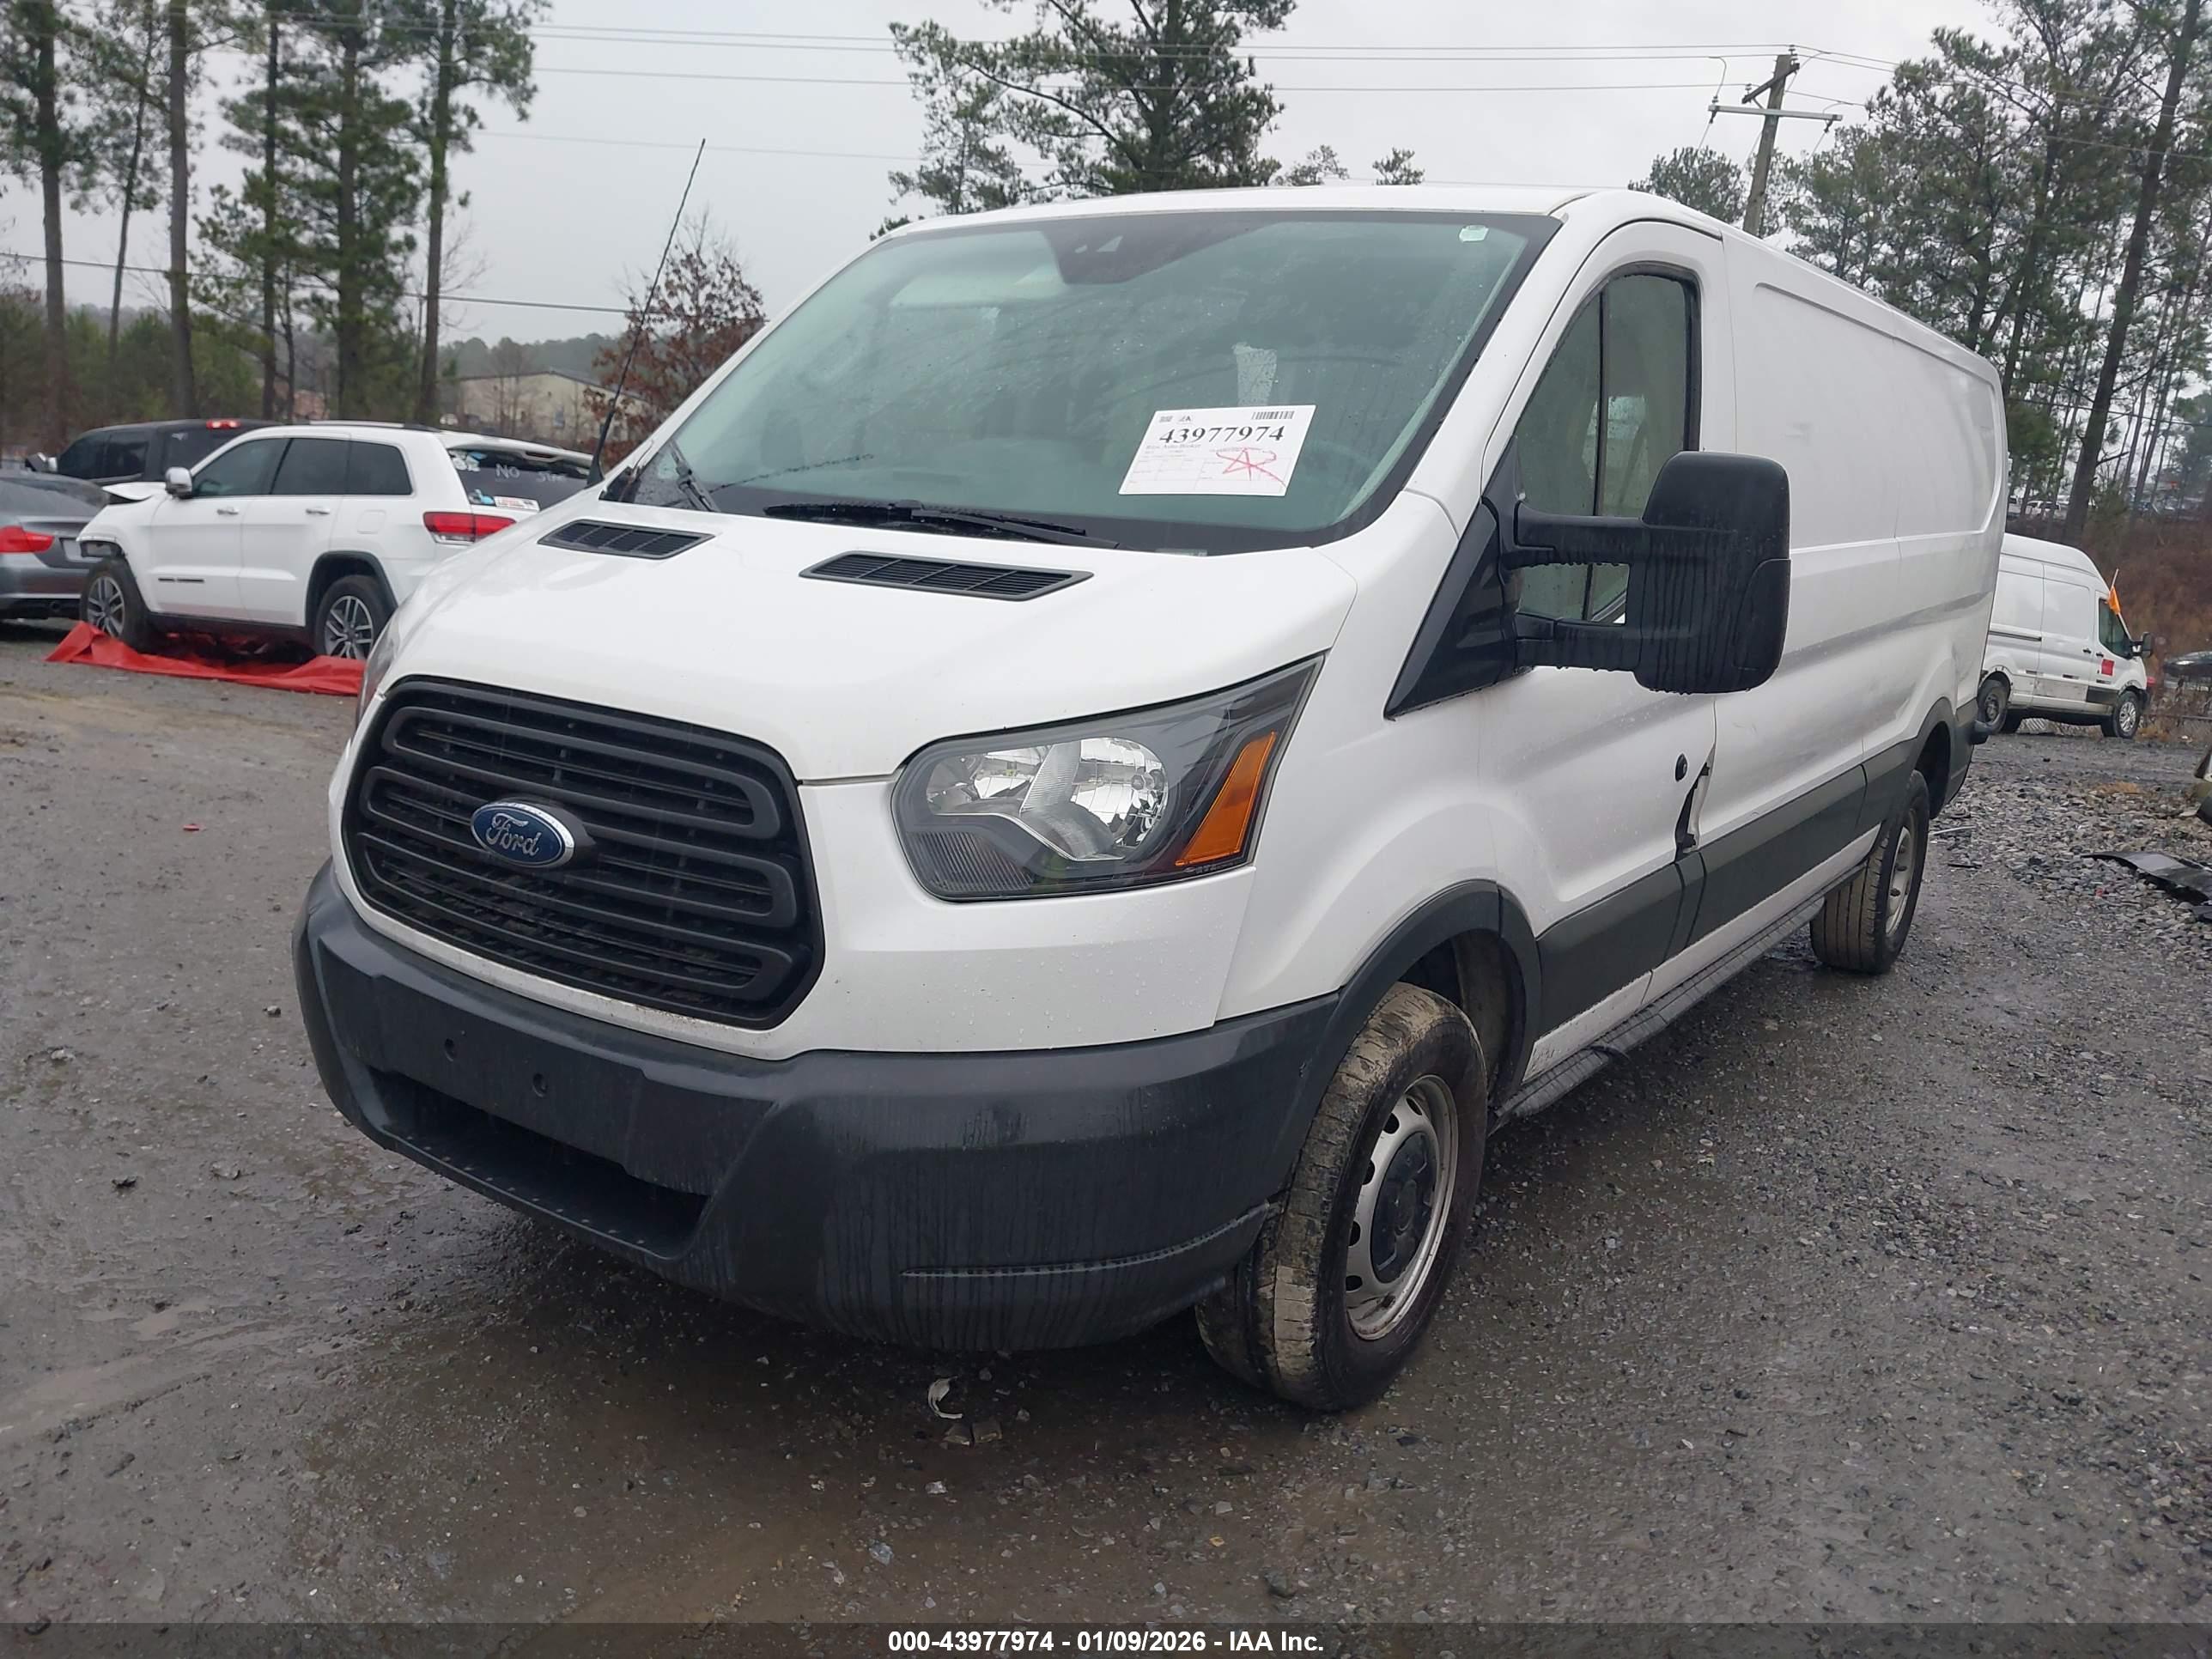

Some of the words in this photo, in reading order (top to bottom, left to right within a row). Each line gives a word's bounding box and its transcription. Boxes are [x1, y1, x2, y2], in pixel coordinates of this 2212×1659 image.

[1159, 425, 1285, 444] 43977974
[495, 463, 520, 479] NO
[485, 812, 542, 856] Ford
